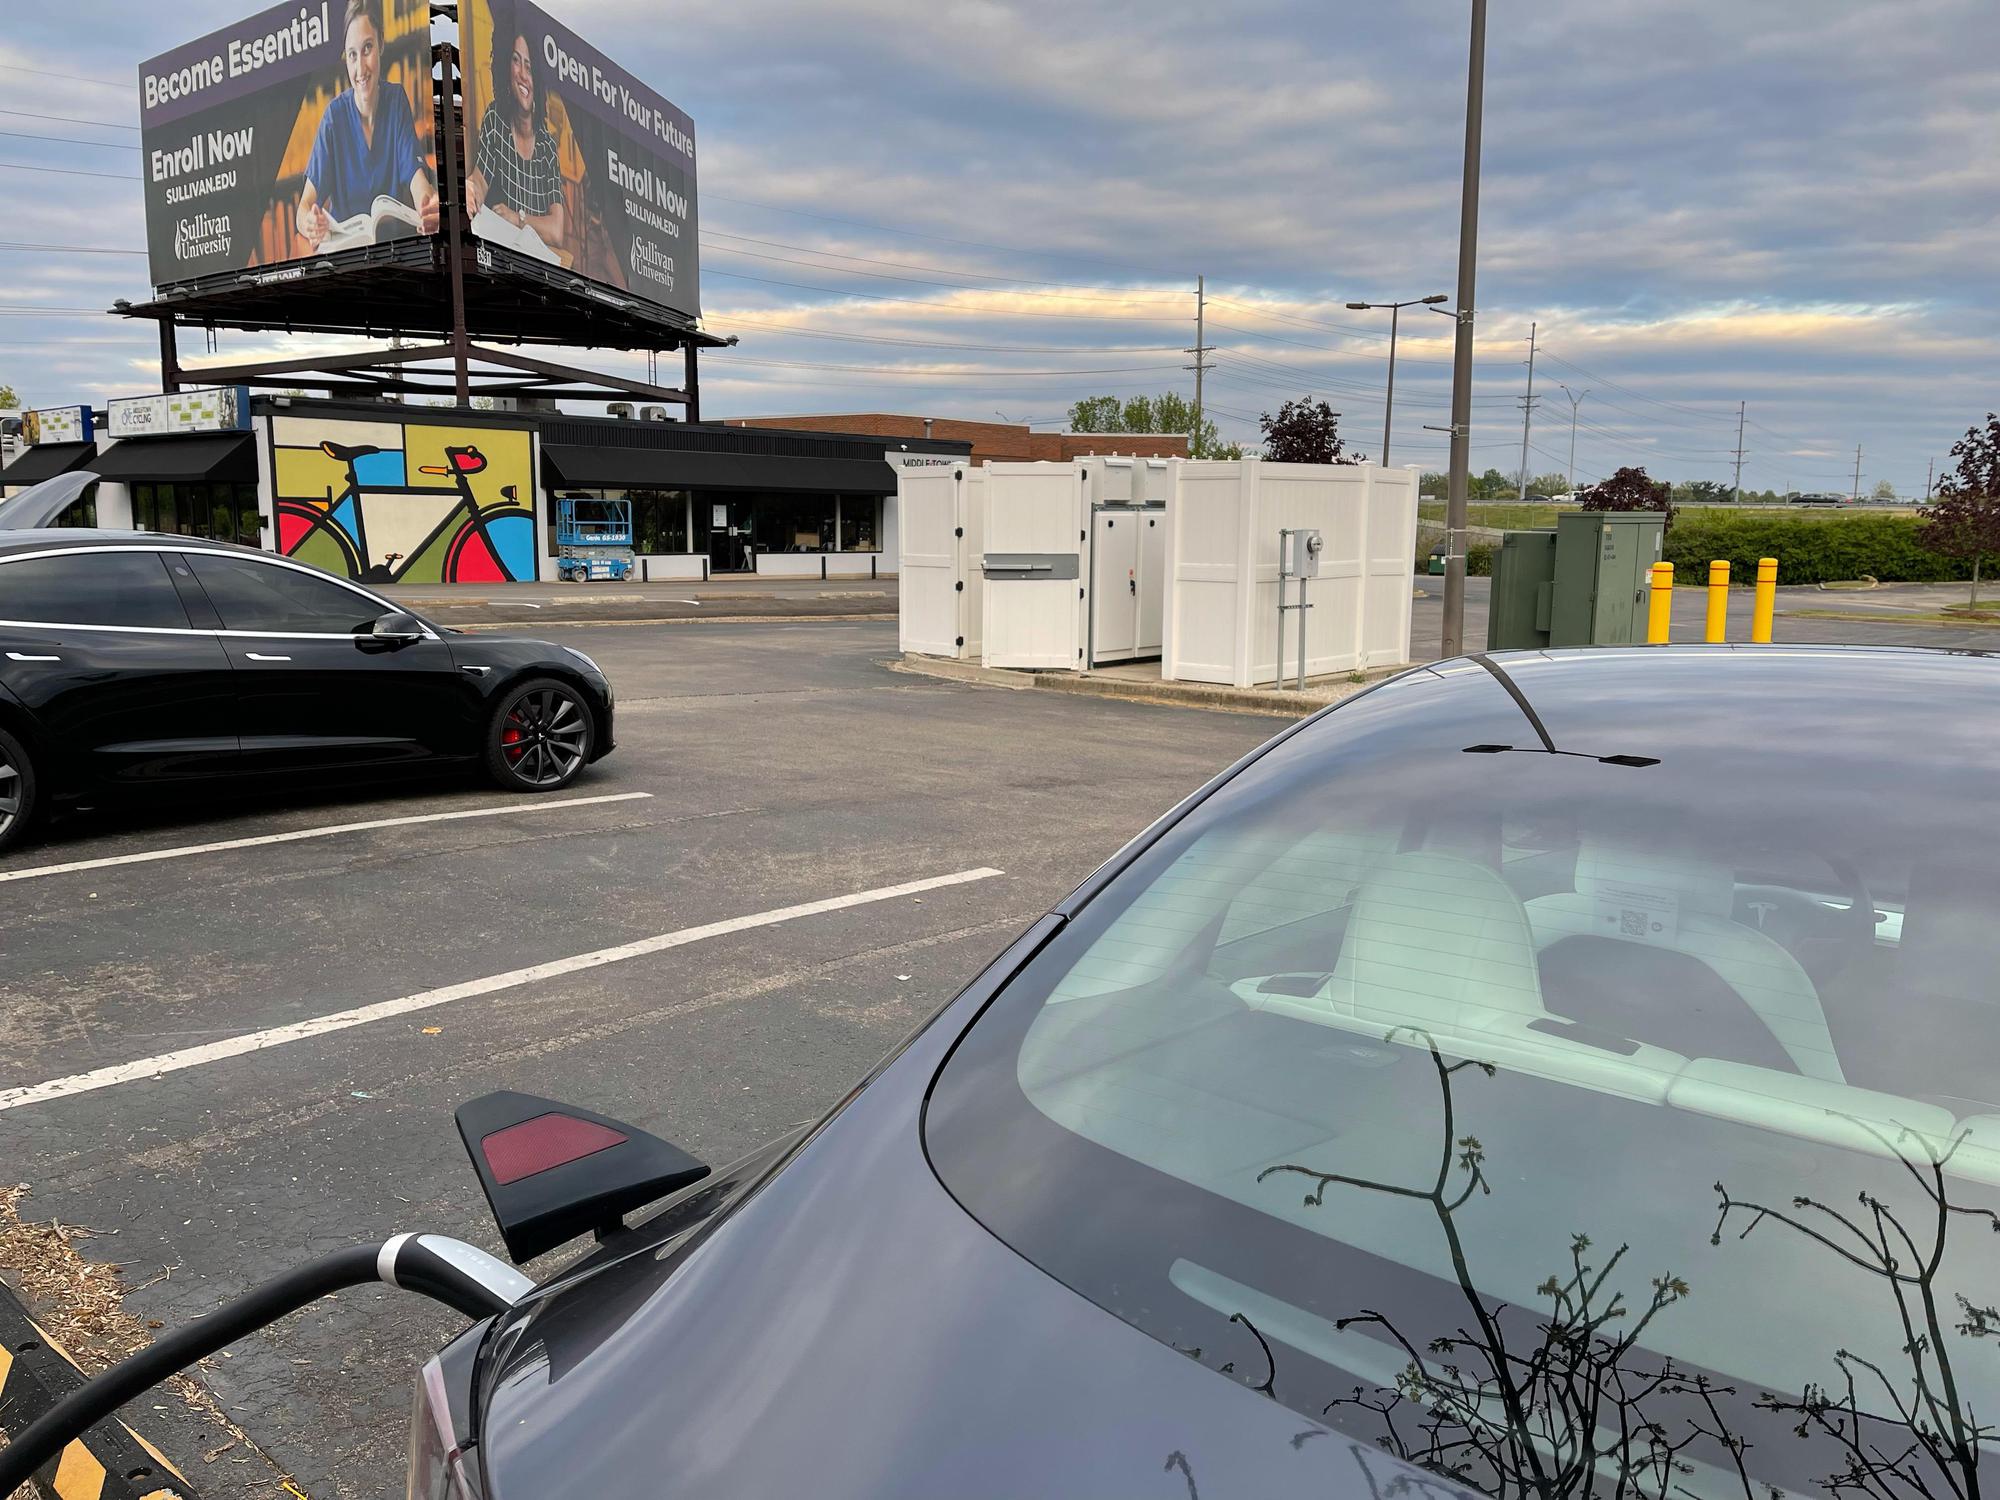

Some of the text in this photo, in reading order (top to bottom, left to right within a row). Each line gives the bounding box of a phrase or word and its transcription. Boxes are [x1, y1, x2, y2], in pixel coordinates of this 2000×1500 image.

[144, 1, 330, 109] Become Essential
[543, 34, 694, 159] Open For Your Future
[151, 127, 253, 182] Enroll Now
[166, 170, 237, 205] SULLIVAN.EDU
[607, 148, 688, 220] Enroll Now
[180, 213, 231, 242] Sullivan
[625, 199, 680, 239] SULLIVAN.EDU
[181, 233, 232, 260] University
[635, 236, 674, 273] Sullivan
[636, 258, 675, 292] University
[132, 413, 152, 425] CYCLING
